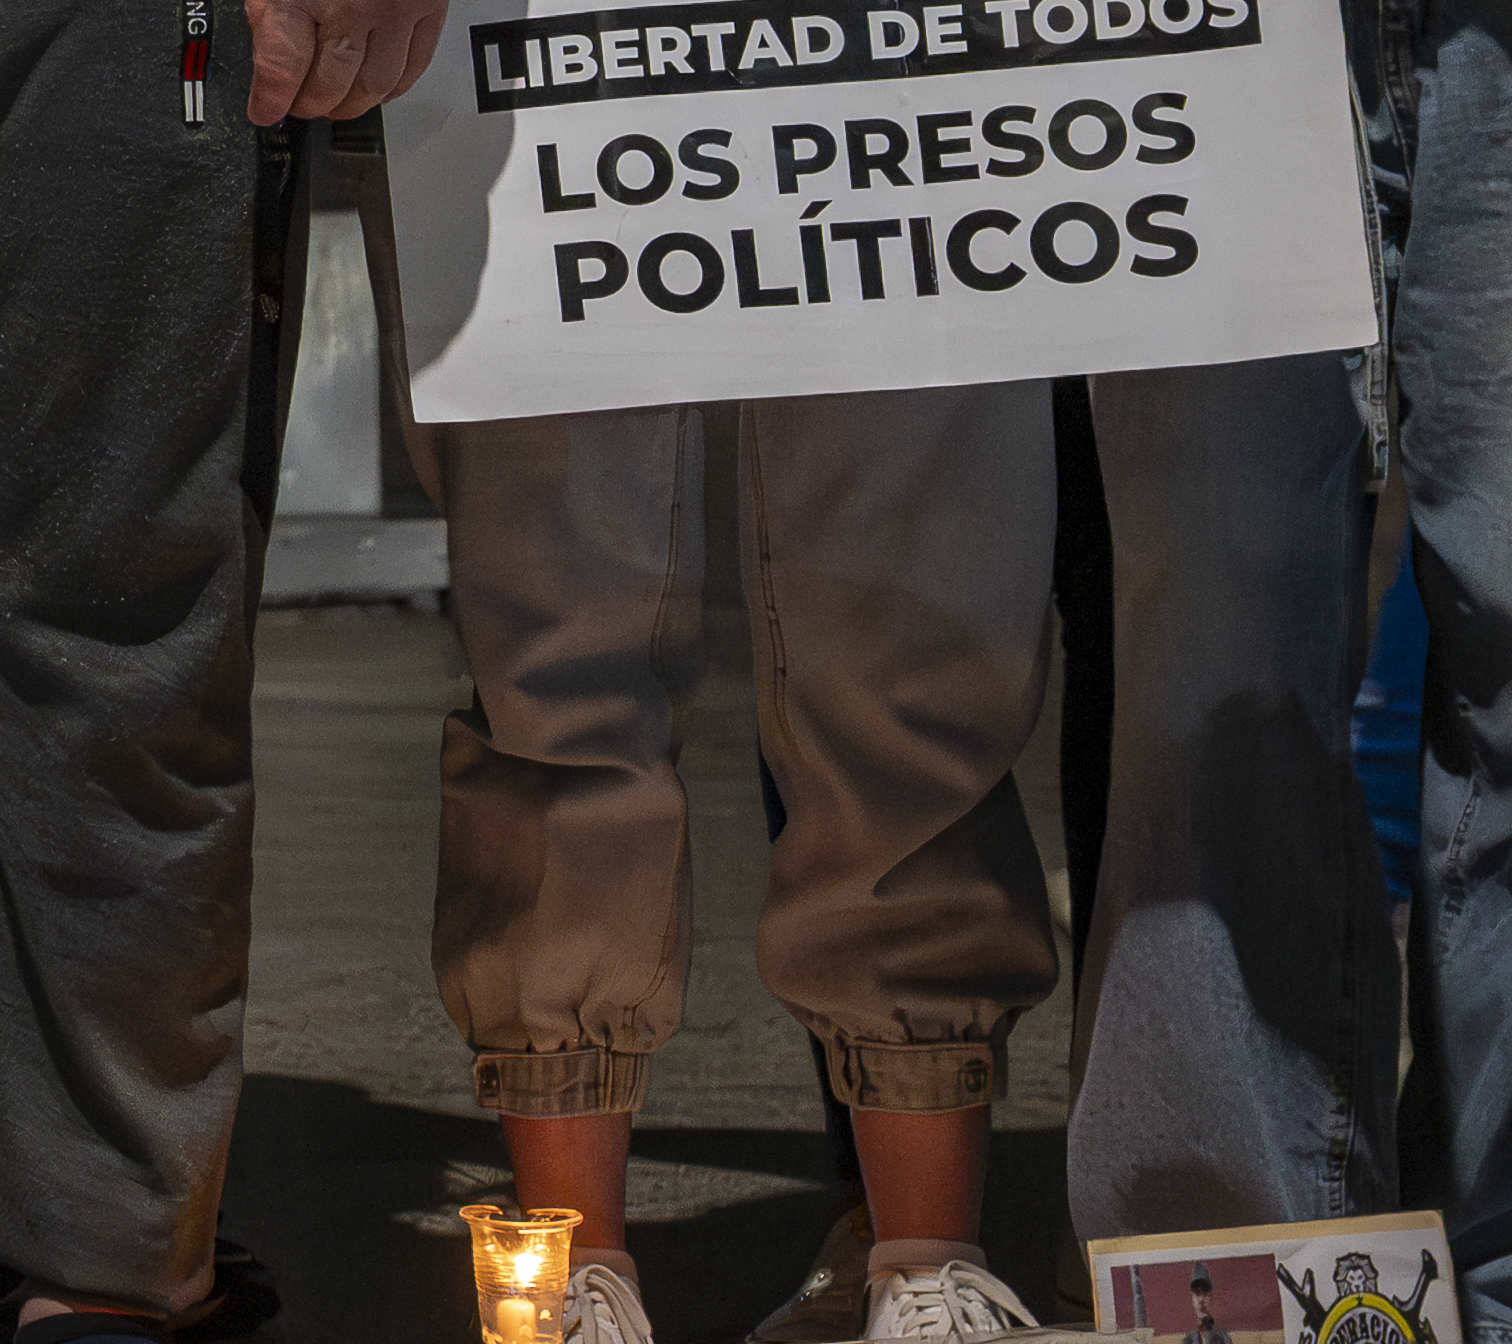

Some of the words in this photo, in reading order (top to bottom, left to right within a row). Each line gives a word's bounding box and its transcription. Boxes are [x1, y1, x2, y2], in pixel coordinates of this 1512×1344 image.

[483, 15, 846, 92] LIBERTAD
[868, 2, 969, 62] DE
[536, 128, 742, 214] LOS
[771, 92, 1197, 195] PRESOS
[552, 192, 1200, 323] POLÍTICOS
